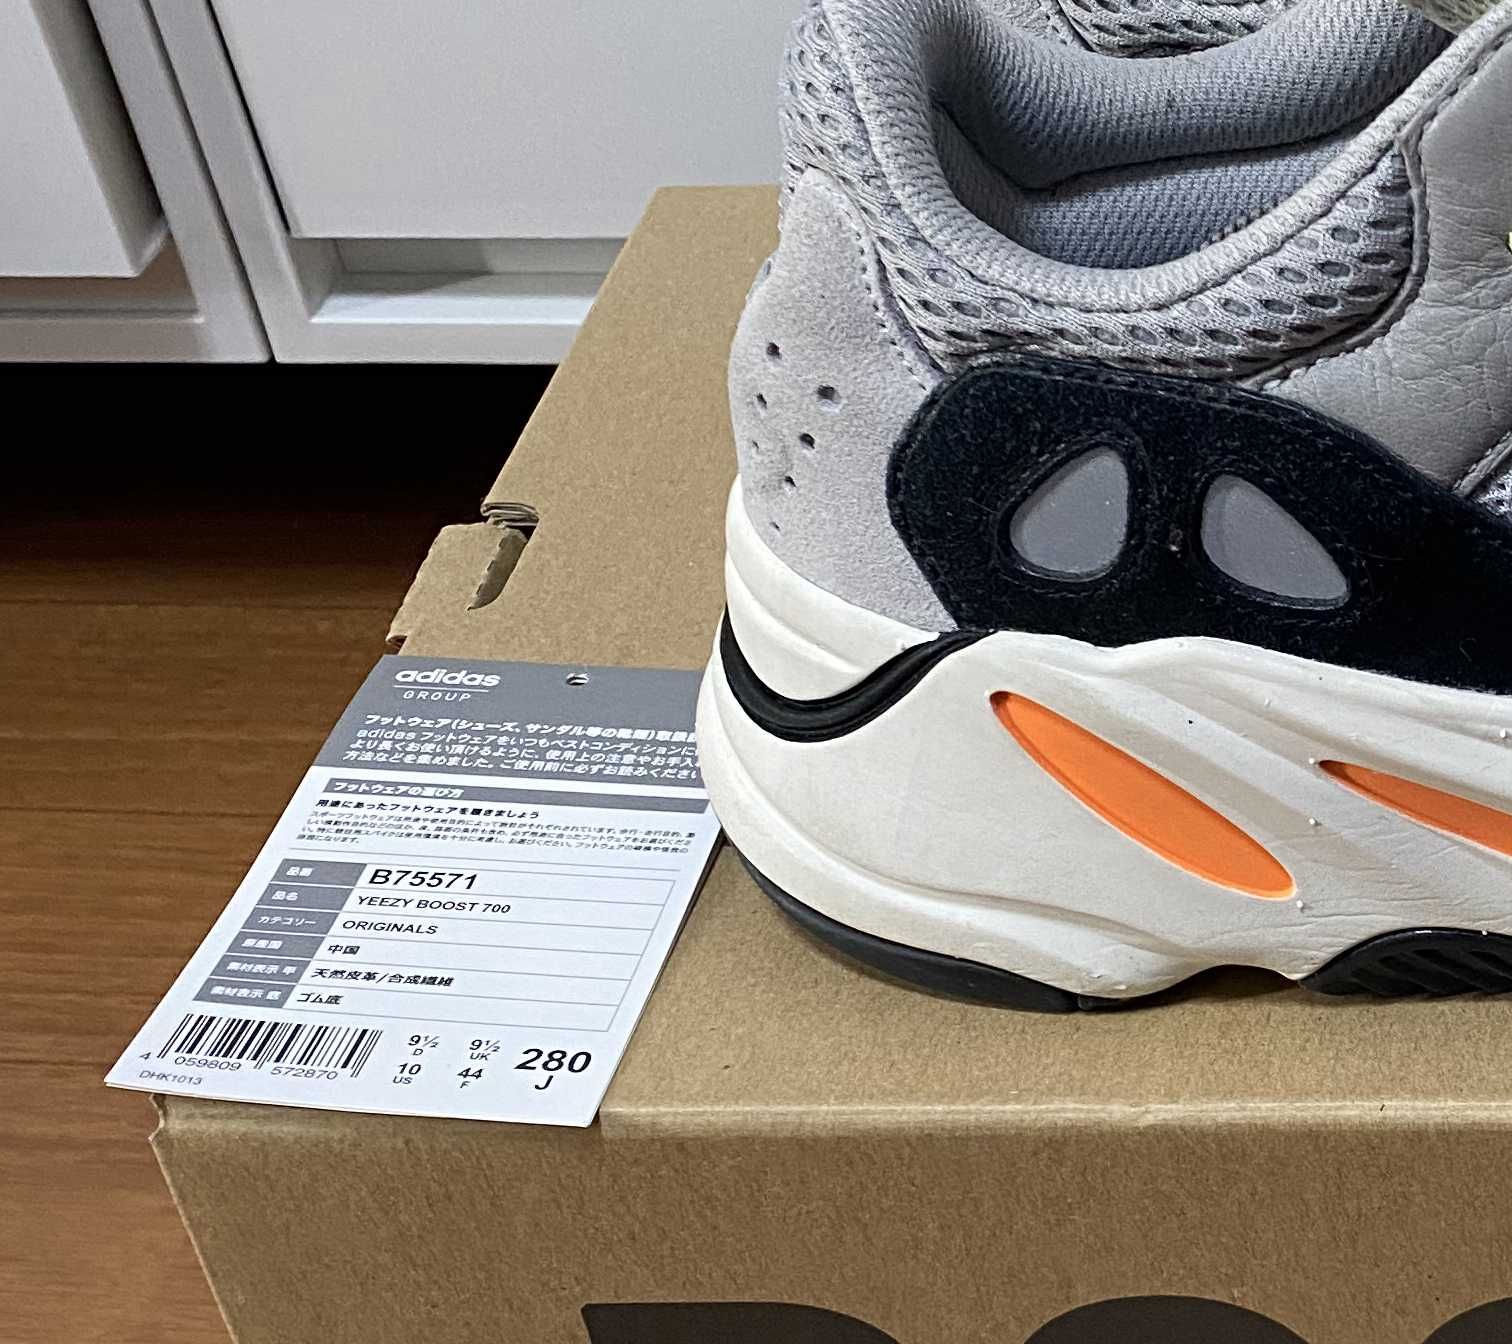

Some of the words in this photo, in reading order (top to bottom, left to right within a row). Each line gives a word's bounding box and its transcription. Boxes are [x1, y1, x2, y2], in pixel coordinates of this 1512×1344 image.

[395, 668, 501, 687] adidas
[403, 690, 472, 702] GROUP
[357, 728, 417, 740] adidas
[420, 731, 698, 756] フットウェアをいつもベストコンディションに
[369, 868, 478, 890] B75571
[271, 890, 299, 901] 品名
[358, 895, 414, 908] YEEZY
[416, 899, 479, 912] BOOST
[481, 903, 512, 914] 700
[342, 920, 439, 935] ORIGINALS
[327, 945, 361, 955] 中国
[311, 968, 455, 987] 天然皮革/合成繊維
[296, 992, 344, 1006] ゴム底
[412, 1048, 424, 1056] D
[470, 1052, 490, 1061] UK
[139, 1051, 151, 1060] 4
[174, 1055, 242, 1071] 059809
[270, 1066, 339, 1080] 572870
[513, 1048, 592, 1073] 280
[398, 1063, 422, 1075] 10
[457, 1067, 483, 1079] 44
[392, 1075, 413, 1085] US
[460, 1080, 471, 1088] F
[534, 1074, 554, 1090] J
